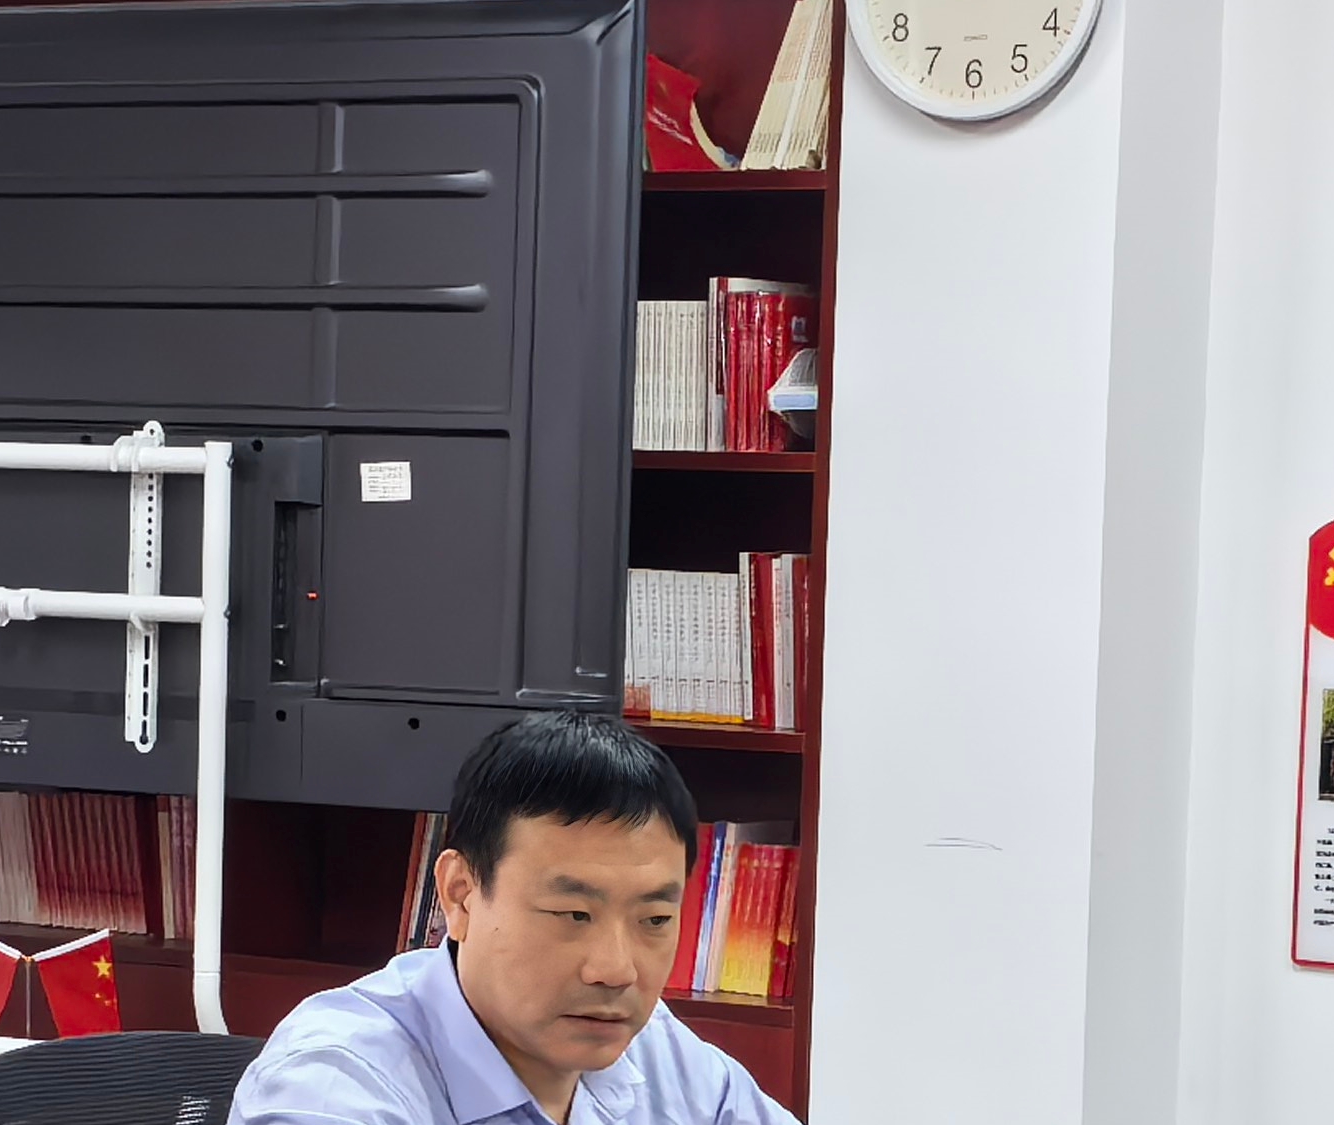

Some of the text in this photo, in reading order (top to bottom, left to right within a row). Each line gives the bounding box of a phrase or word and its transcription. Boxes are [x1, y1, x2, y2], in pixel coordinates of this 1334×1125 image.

[892, 13, 909, 42] 8
[1042, 8, 1060, 37] 4
[924, 46, 942, 75] 7
[1010, 44, 1028, 73] 5
[965, 59, 983, 88] 6
